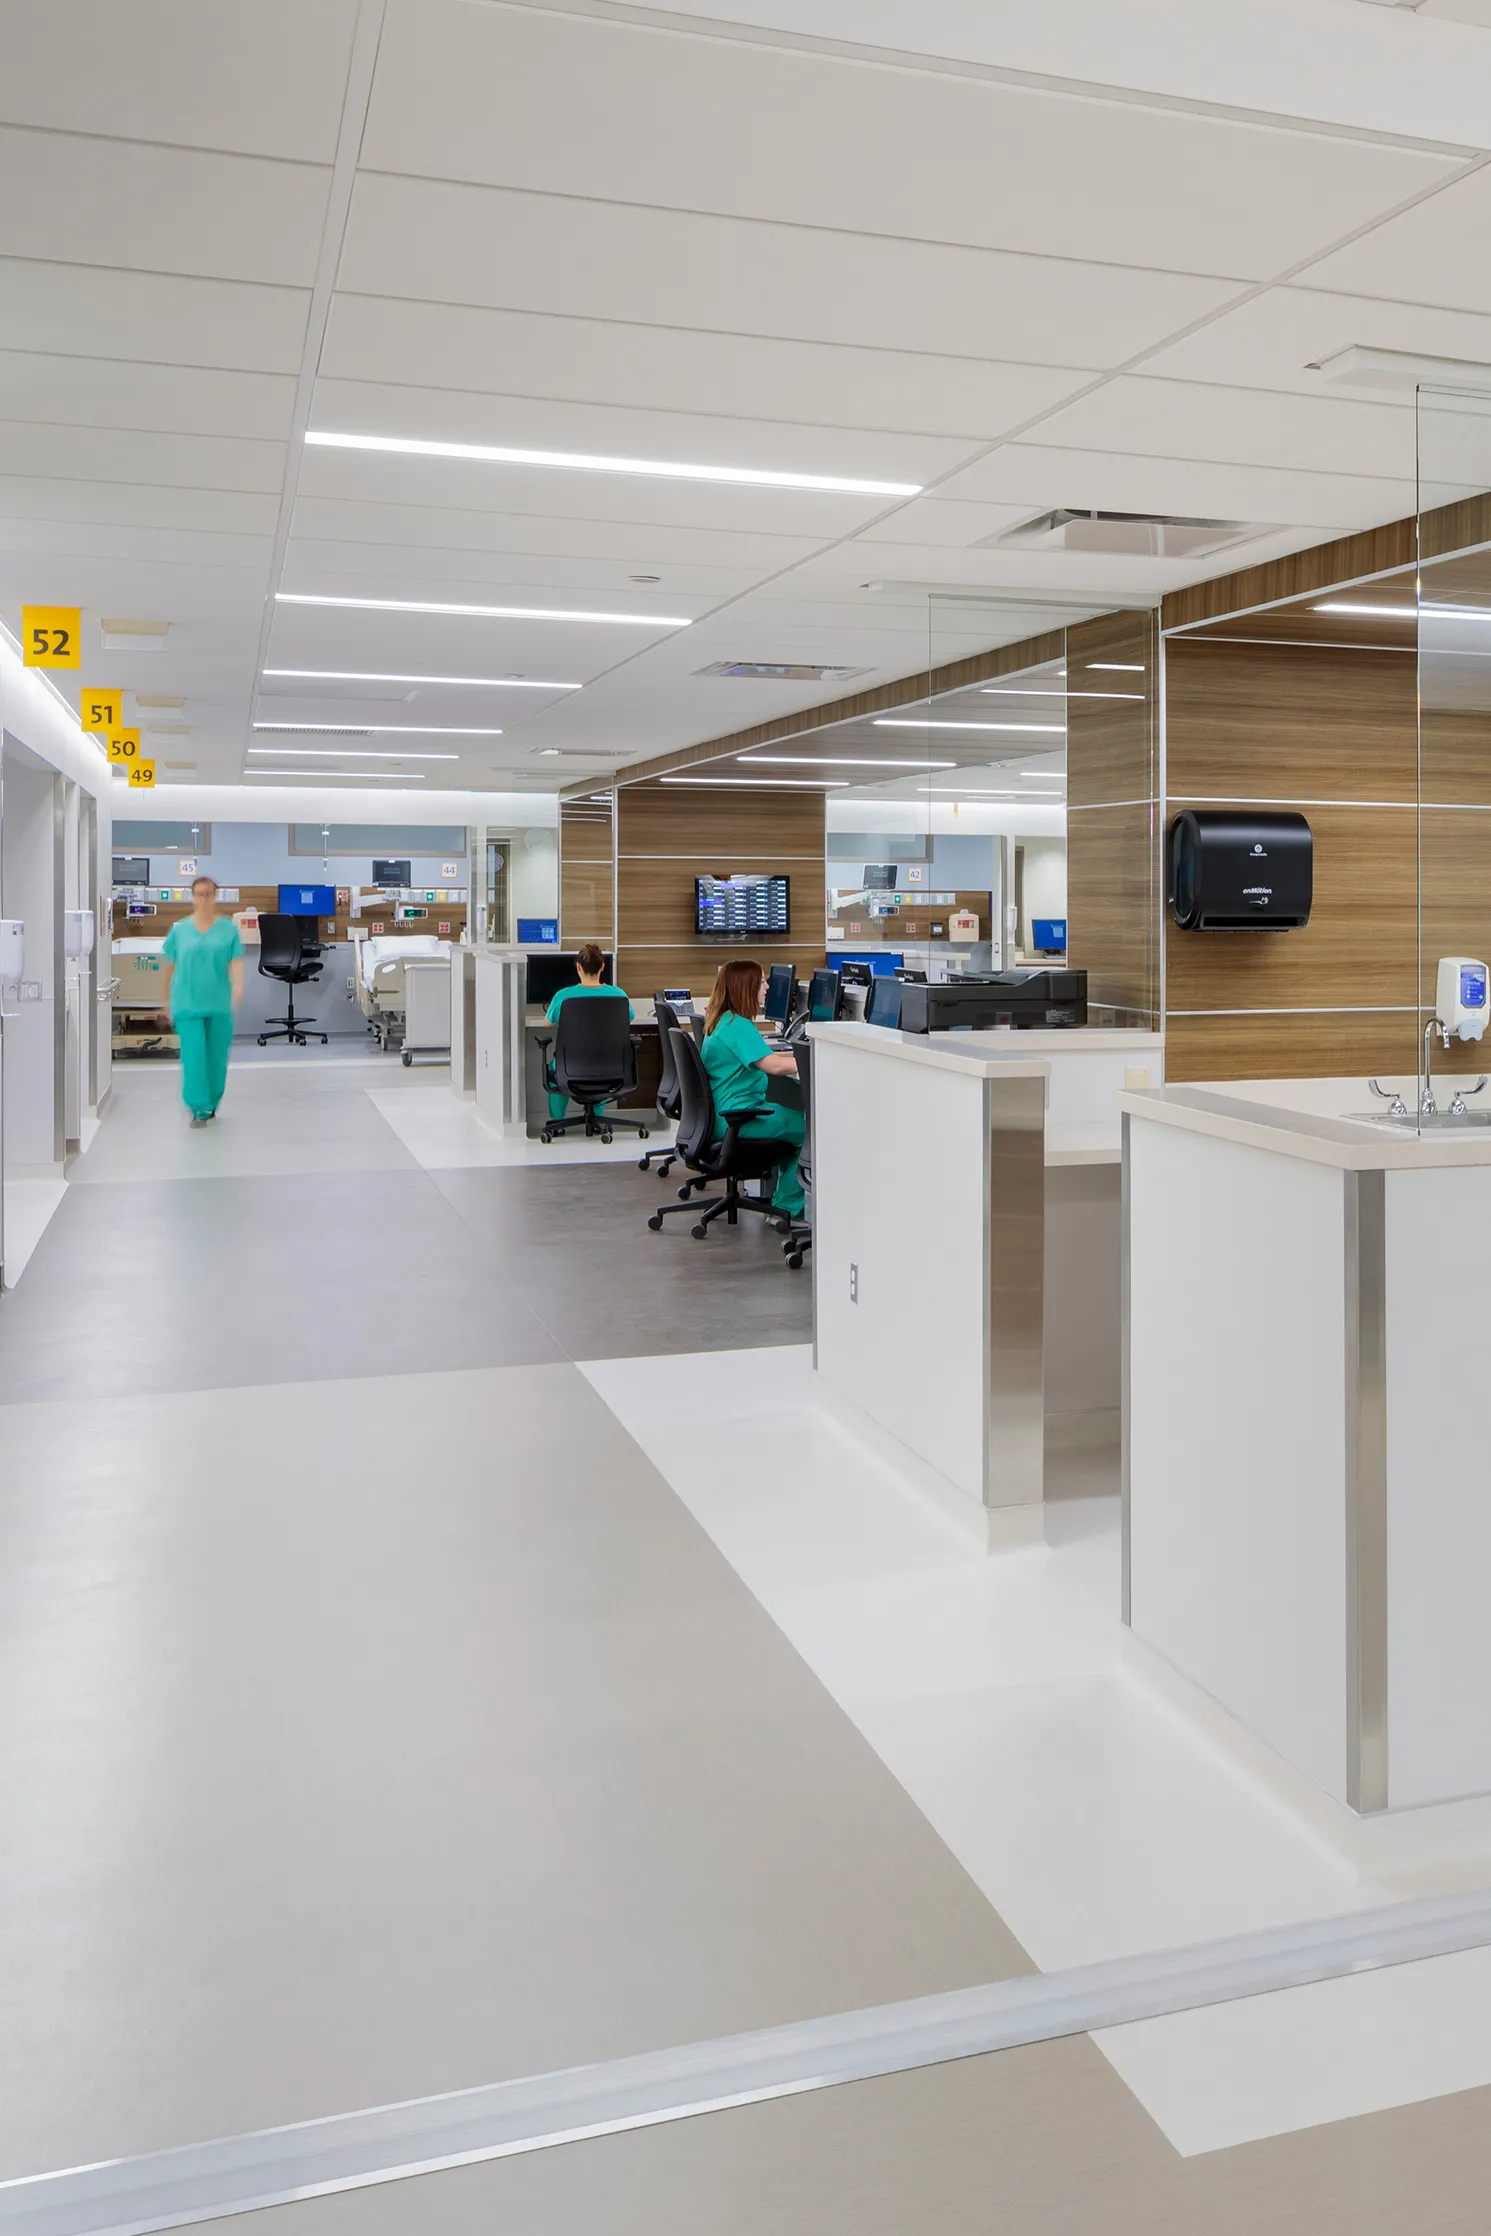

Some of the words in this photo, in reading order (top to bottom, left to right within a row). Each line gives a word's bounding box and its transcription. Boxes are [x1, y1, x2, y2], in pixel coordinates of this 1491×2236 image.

[32, 628, 71, 656] 52
[90, 704, 114, 725] 51
[110, 740, 136, 757] 50
[131, 769, 153, 783] 49
[181, 863, 194, 873] 45
[443, 866, 456, 875] 44
[910, 870, 921, 879] 42
